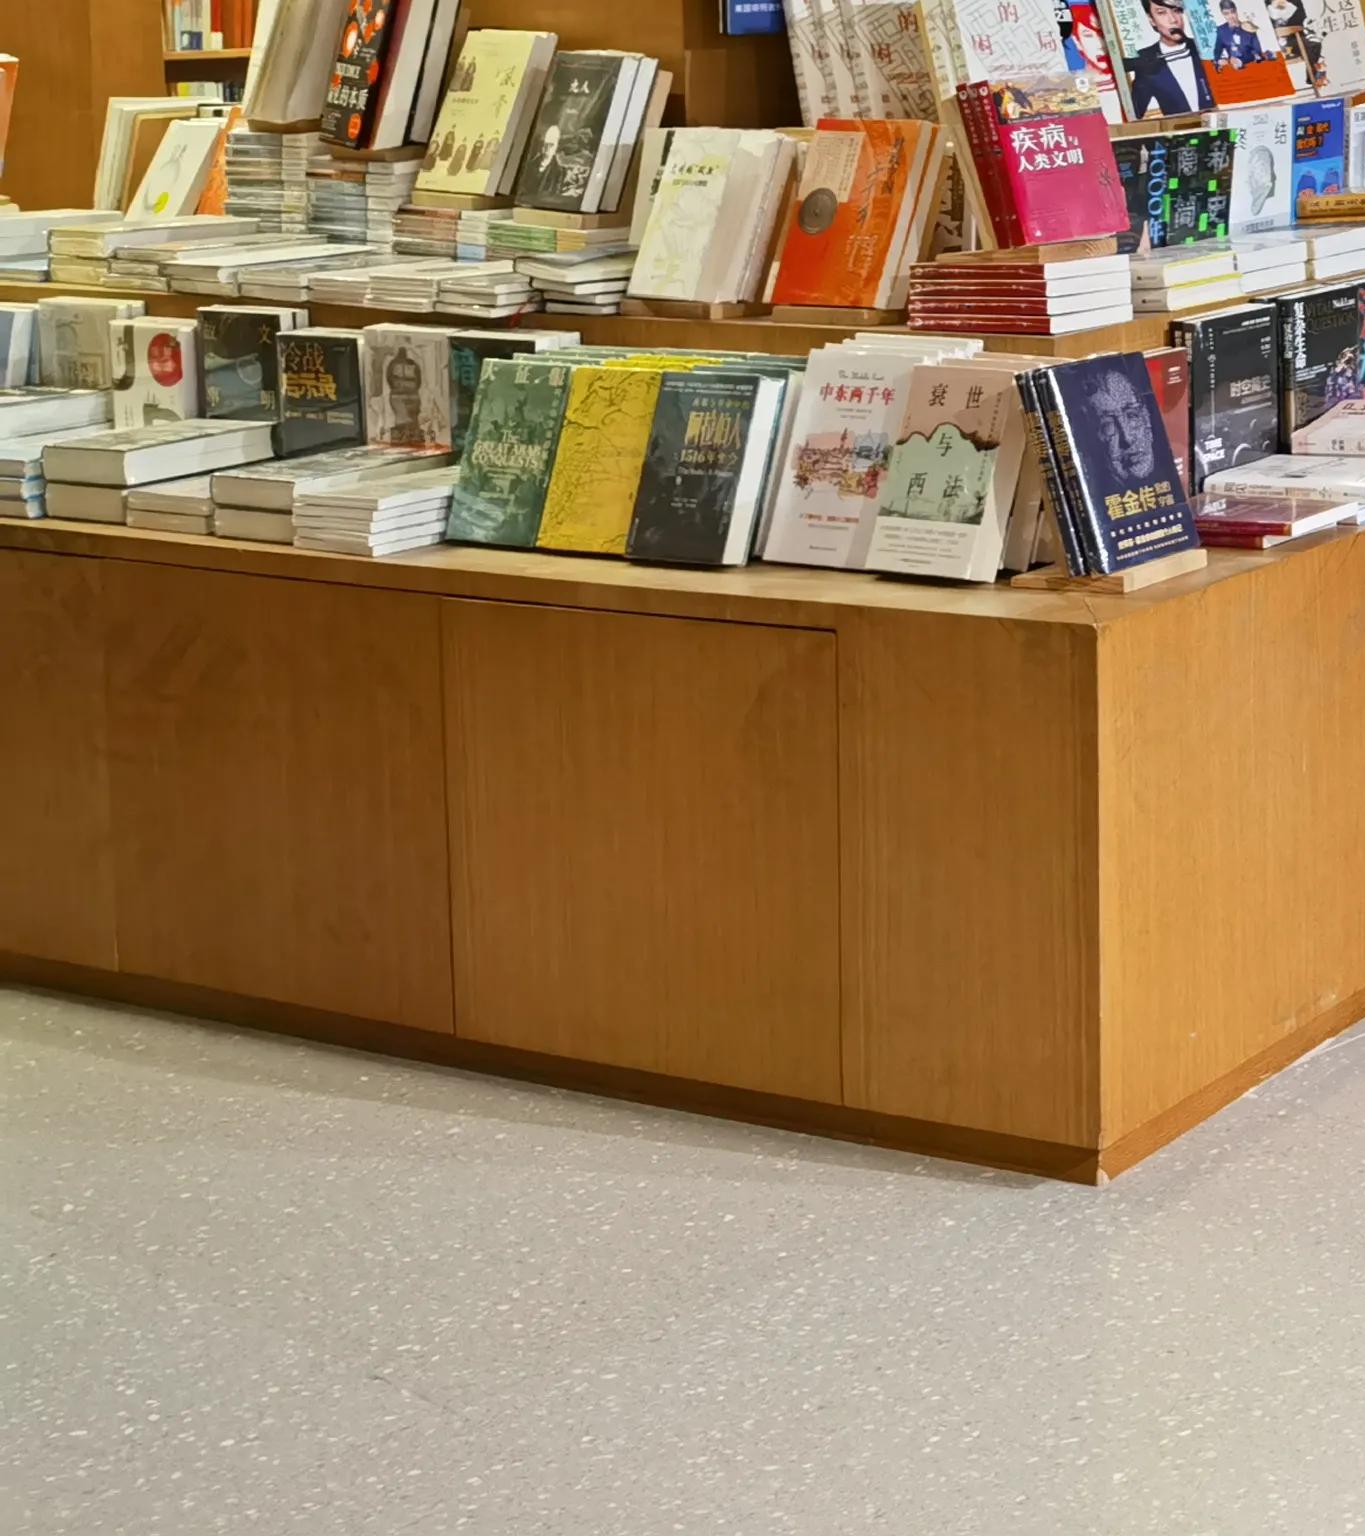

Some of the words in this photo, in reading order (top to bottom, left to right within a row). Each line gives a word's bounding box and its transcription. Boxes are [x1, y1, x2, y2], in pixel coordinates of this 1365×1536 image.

[997, 0, 1019, 24] 的
[970, 33, 993, 57] 困
[1018, 148, 1085, 173] 人类文明
[258, 325, 272, 345] 文
[280, 341, 326, 373] 冷战
[260, 390, 276, 411] 明
[819, 382, 897, 406] 中东两千年
[966, 385, 985, 410] 世
[684, 410, 741, 450] 阿拉伯人
[936, 433, 953, 458] 与
[908, 471, 929, 497] 西
[943, 474, 964, 500] 法
[1105, 486, 1158, 521] 霍金传
